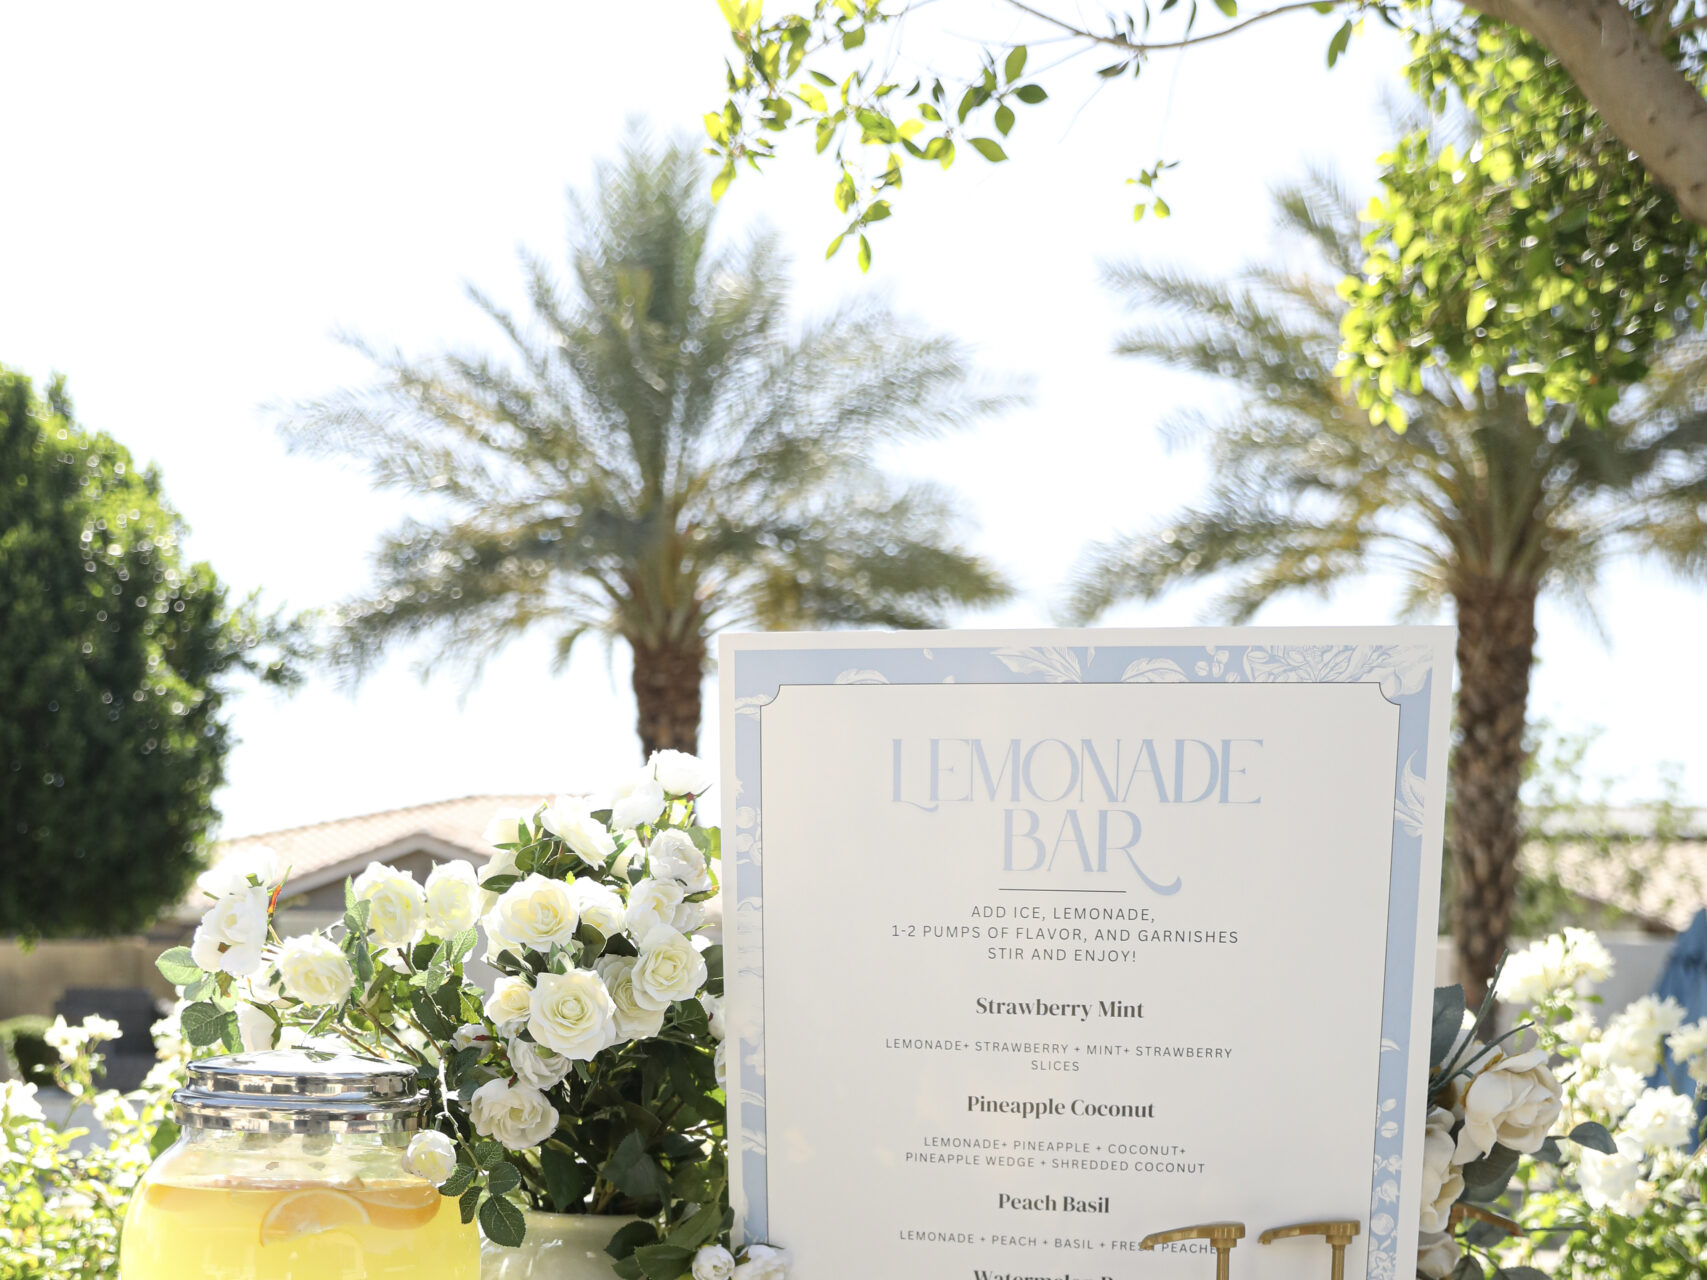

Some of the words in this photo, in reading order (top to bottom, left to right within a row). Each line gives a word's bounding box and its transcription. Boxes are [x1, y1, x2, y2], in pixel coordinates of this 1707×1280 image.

[891, 738, 1264, 813] LEMONADE
[1002, 808, 1182, 896] BAR
[971, 905, 1006, 919] ADD
[1014, 906, 1045, 921] ICE,
[1054, 904, 1155, 923] LEMONADE,
[892, 925, 915, 937] 1-2
[923, 925, 980, 938] PUMPS
[988, 927, 1008, 941] OF
[1016, 927, 1087, 943] FLAVOR,
[1094, 929, 1130, 944] AND
[1137, 930, 1238, 944] GARNISHES
[988, 947, 1023, 960] STIR
[1031, 948, 1066, 961] AND
[1074, 949, 1135, 962] ENJOY!
[976, 997, 1093, 1022] Strawberry
[1098, 1000, 1144, 1018] Mint
[975, 1041, 1068, 1054] STRAWBERRY
[1136, 1046, 1232, 1058] STRAWBERRY
[1031, 1060, 1080, 1071] SLICES
[968, 1096, 1065, 1119] Pineapple
[1071, 1099, 1155, 1118] Coconut
[1014, 1140, 1090, 1153] PINEAPPLE
[906, 1152, 980, 1165] PINEAPPLE
[986, 1156, 1035, 1167] WEDGE
[1052, 1158, 1128, 1171] SHREDDED
[1135, 1161, 1205, 1173] COCONUT
[999, 1193, 1057, 1211] Peach
[1062, 1196, 1109, 1213] Basil
[899, 1230, 974, 1244] LEMONADE
[992, 1235, 1036, 1246] PEACH
[1055, 1238, 1093, 1249] BASIL
[1111, 1239, 1157, 1251] FRES
[1161, 1241, 1216, 1255] PEACHE
